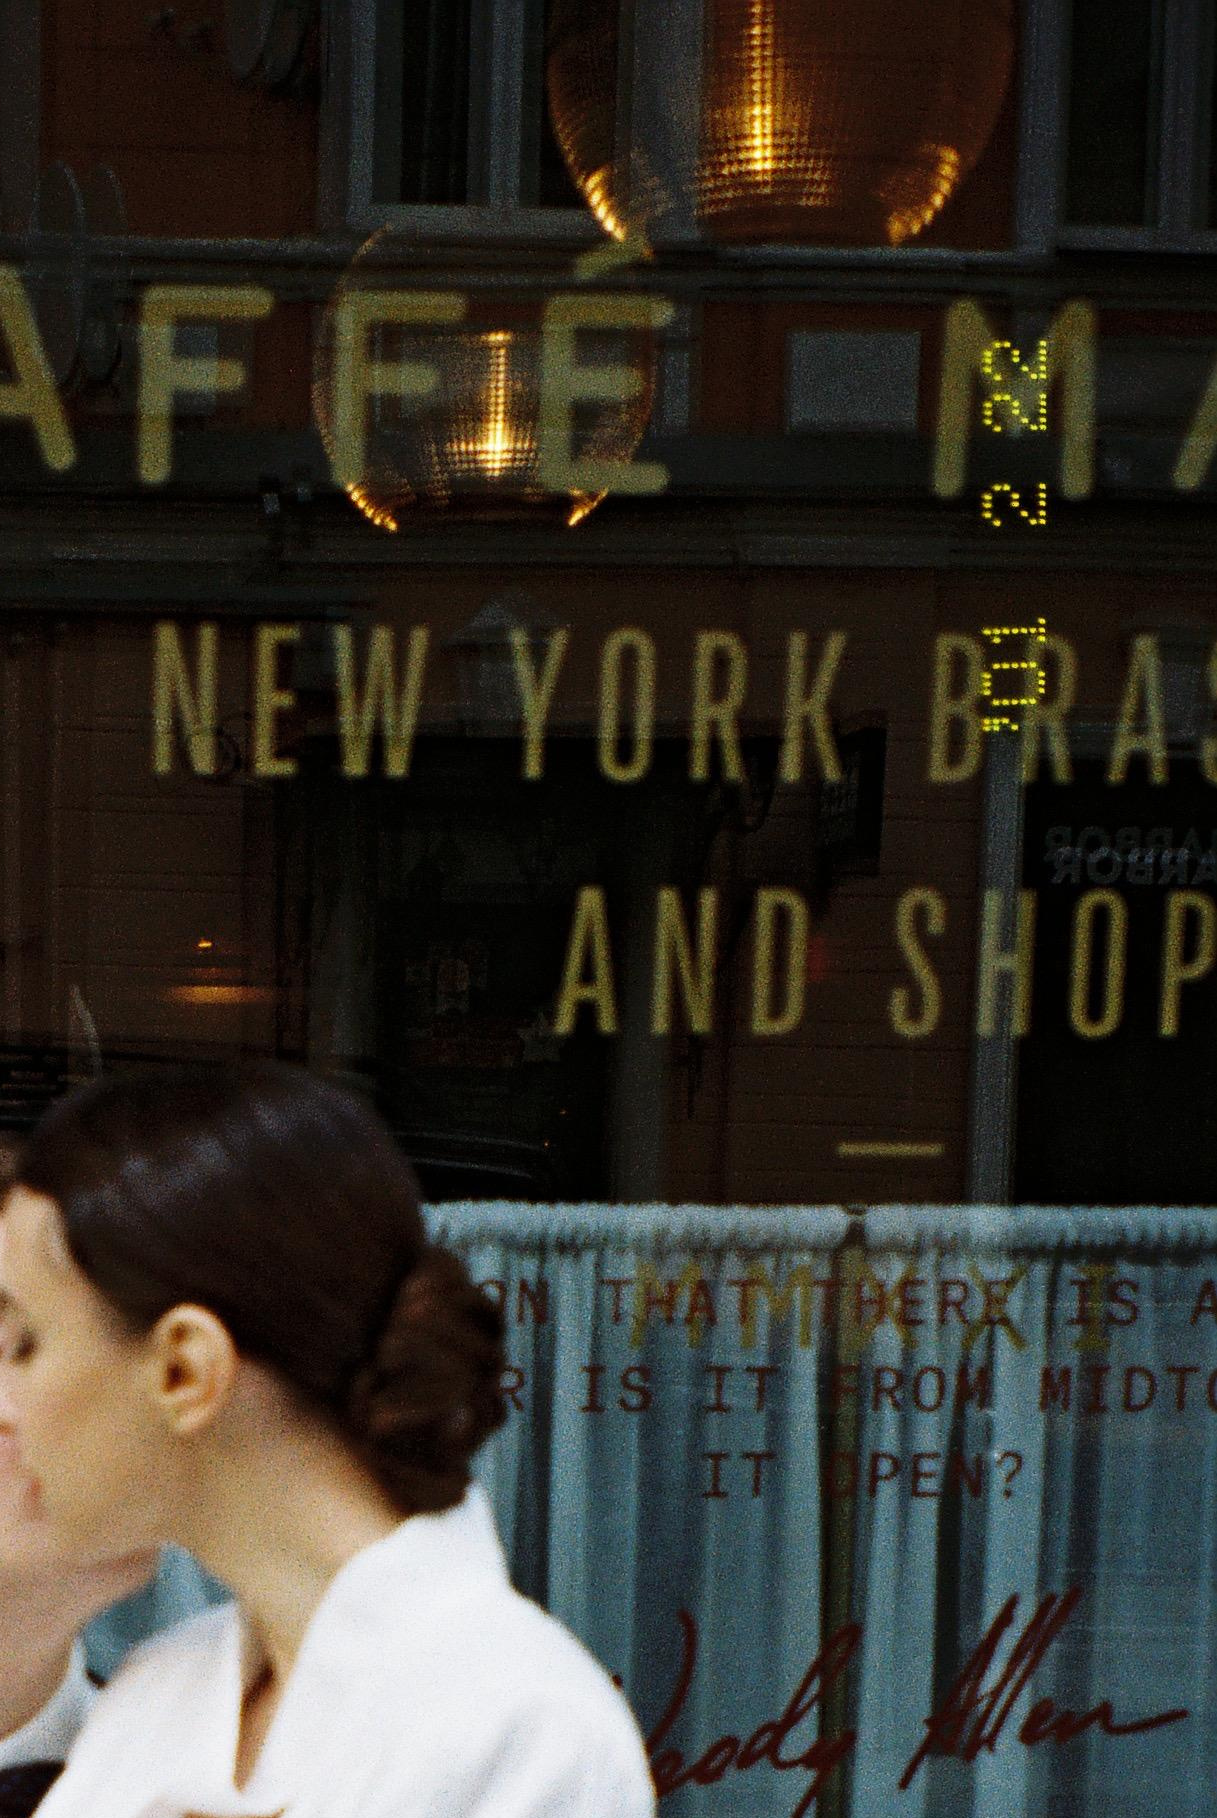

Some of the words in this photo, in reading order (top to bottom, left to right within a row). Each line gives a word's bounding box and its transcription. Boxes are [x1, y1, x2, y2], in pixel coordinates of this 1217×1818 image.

[152, 621, 430, 779] NEW
[508, 626, 849, 783] YORK
[552, 885, 811, 1036] AND
[887, 886, 1217, 1040] SHOP
[599, 1277, 766, 1326] THAT
[812, 1278, 1014, 1328] THERE
[1066, 1278, 1139, 1327] IS
[578, 1364, 653, 1413] IS
[703, 1364, 778, 1413] IT
[834, 1364, 990, 1414] FROM
[701, 1451, 778, 1499] IT
[824, 1450, 1025, 1500] OPEN?
